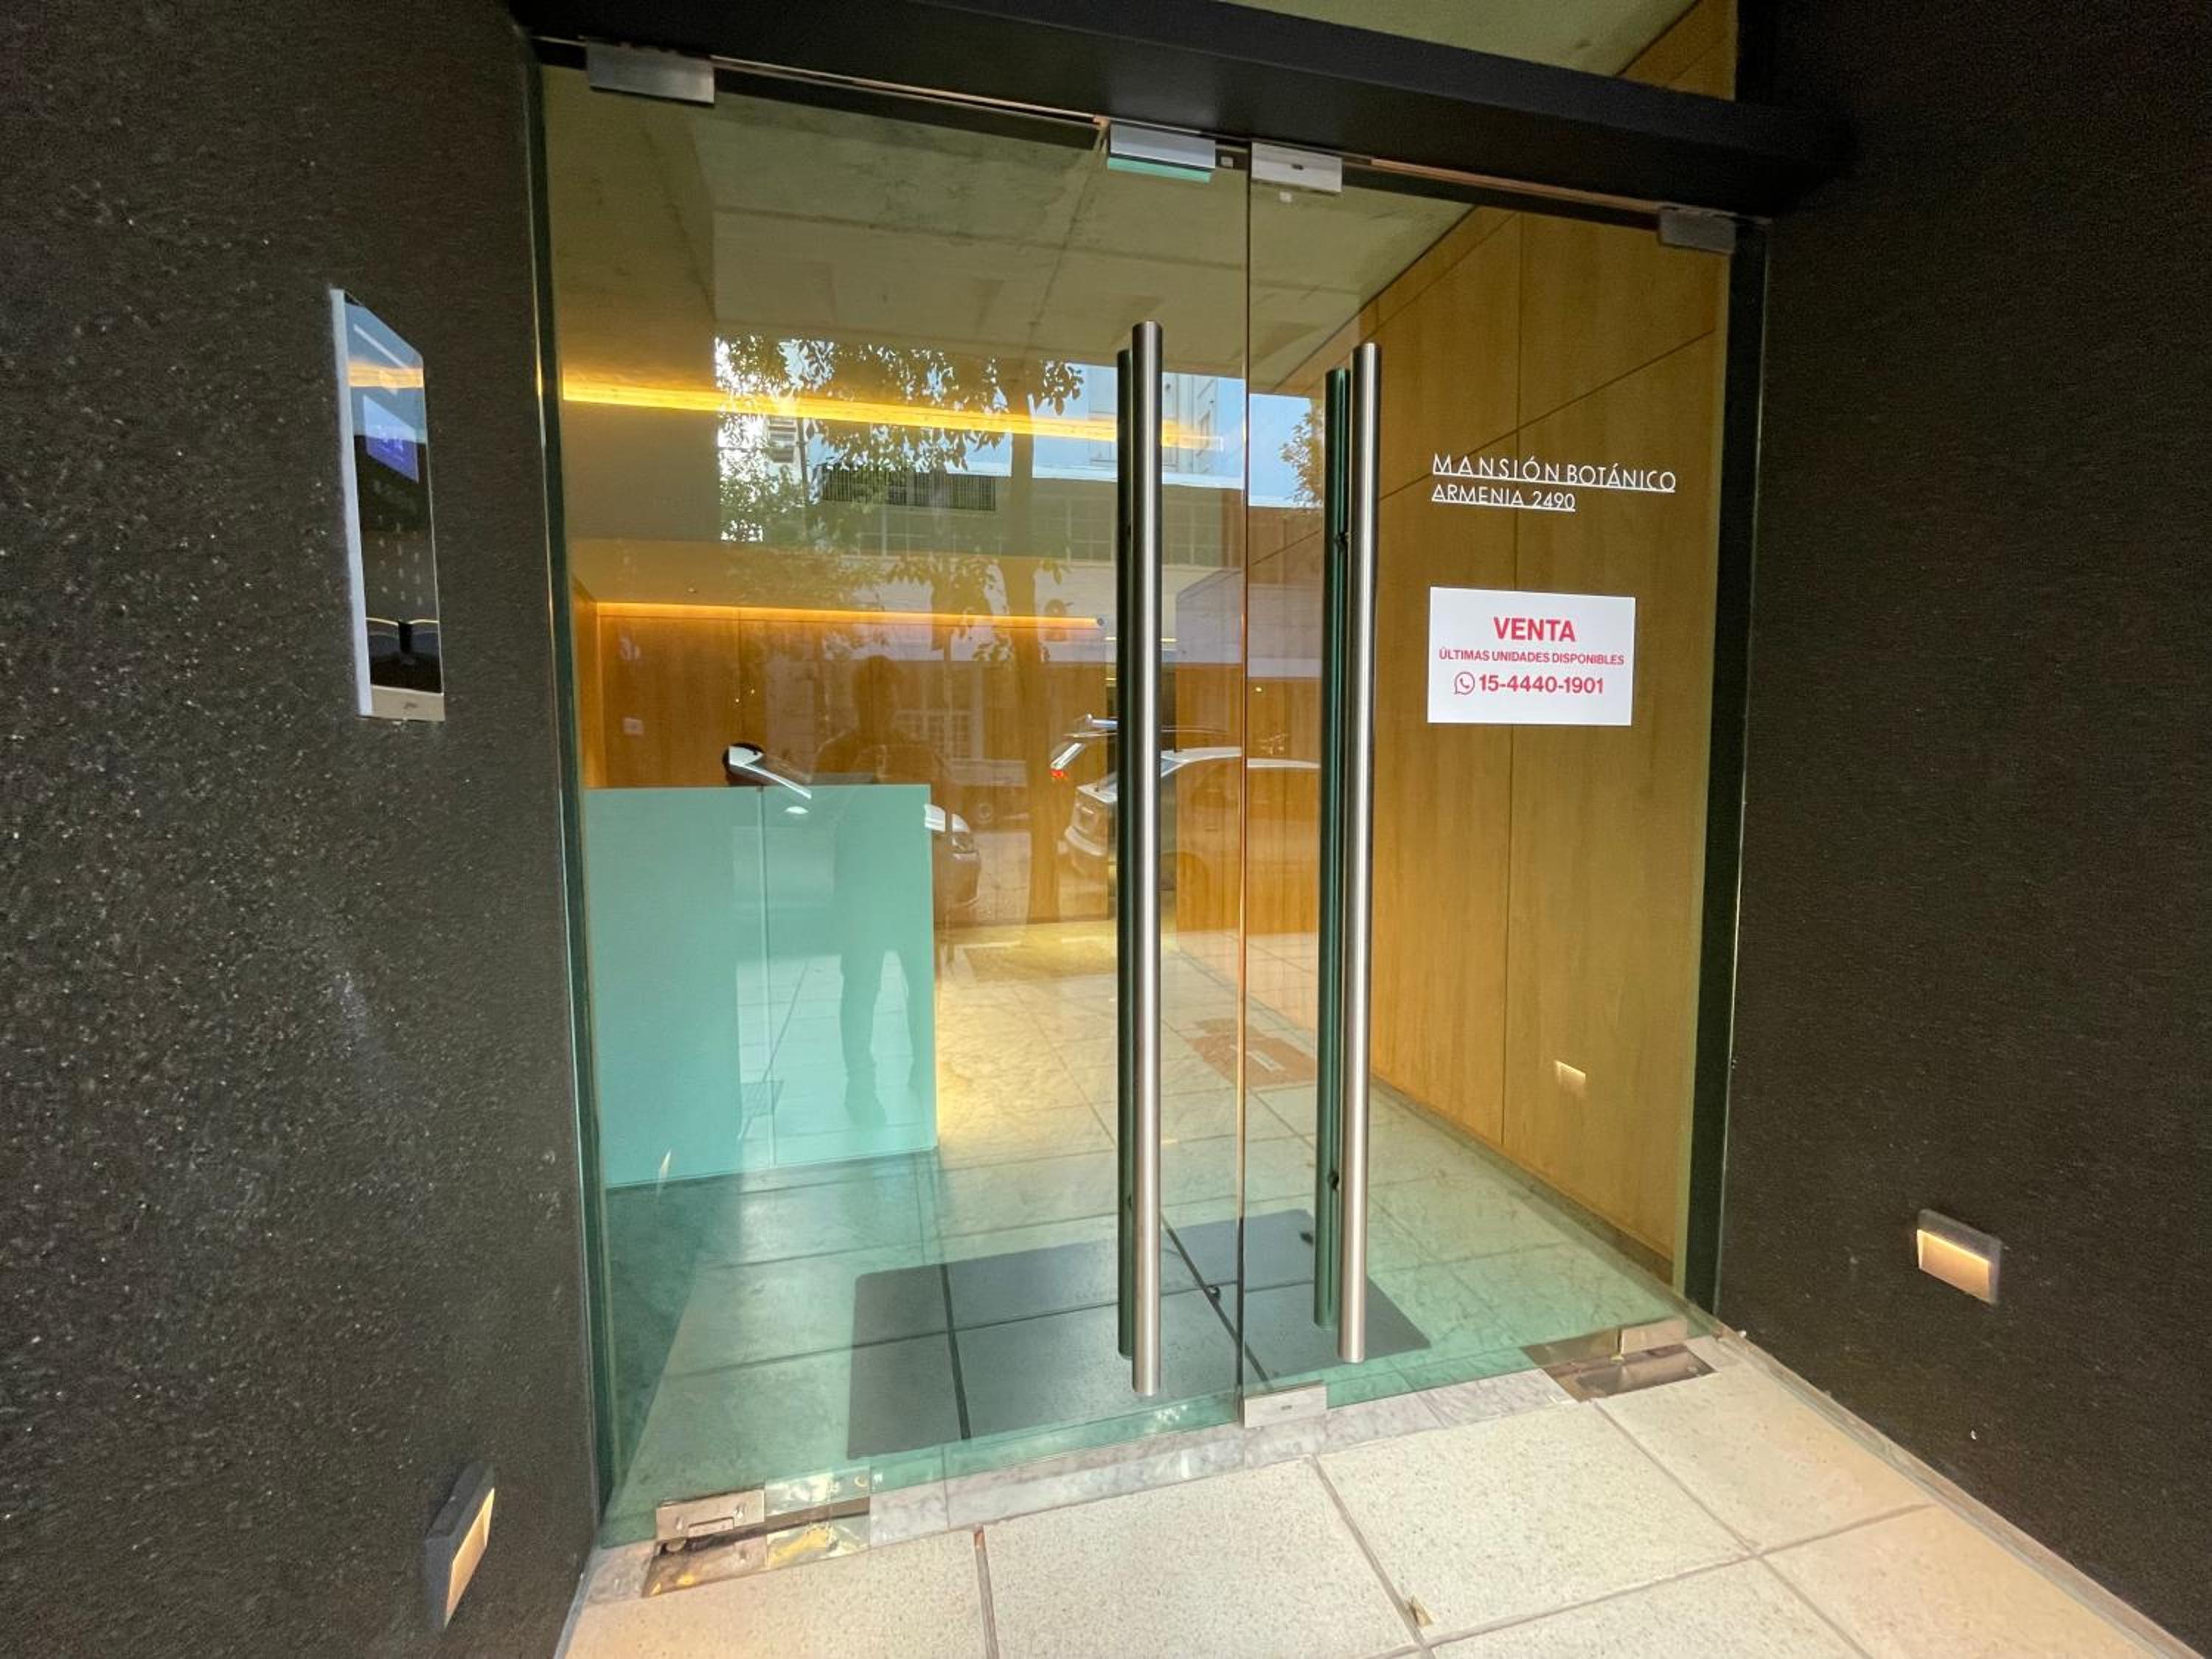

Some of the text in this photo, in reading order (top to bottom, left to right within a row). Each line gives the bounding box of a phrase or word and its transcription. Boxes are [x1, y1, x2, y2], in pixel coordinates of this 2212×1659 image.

[1432, 452, 1677, 492] MANSIÓN BOTÁNICO
[1431, 483, 1576, 511] ARMENIA 2490
[1492, 616, 1576, 642] VENTA
[1492, 650, 1550, 664] UNIDADES
[1552, 653, 1625, 665] DISPONIBLES
[1478, 673, 1604, 694] 15-4440-1901
